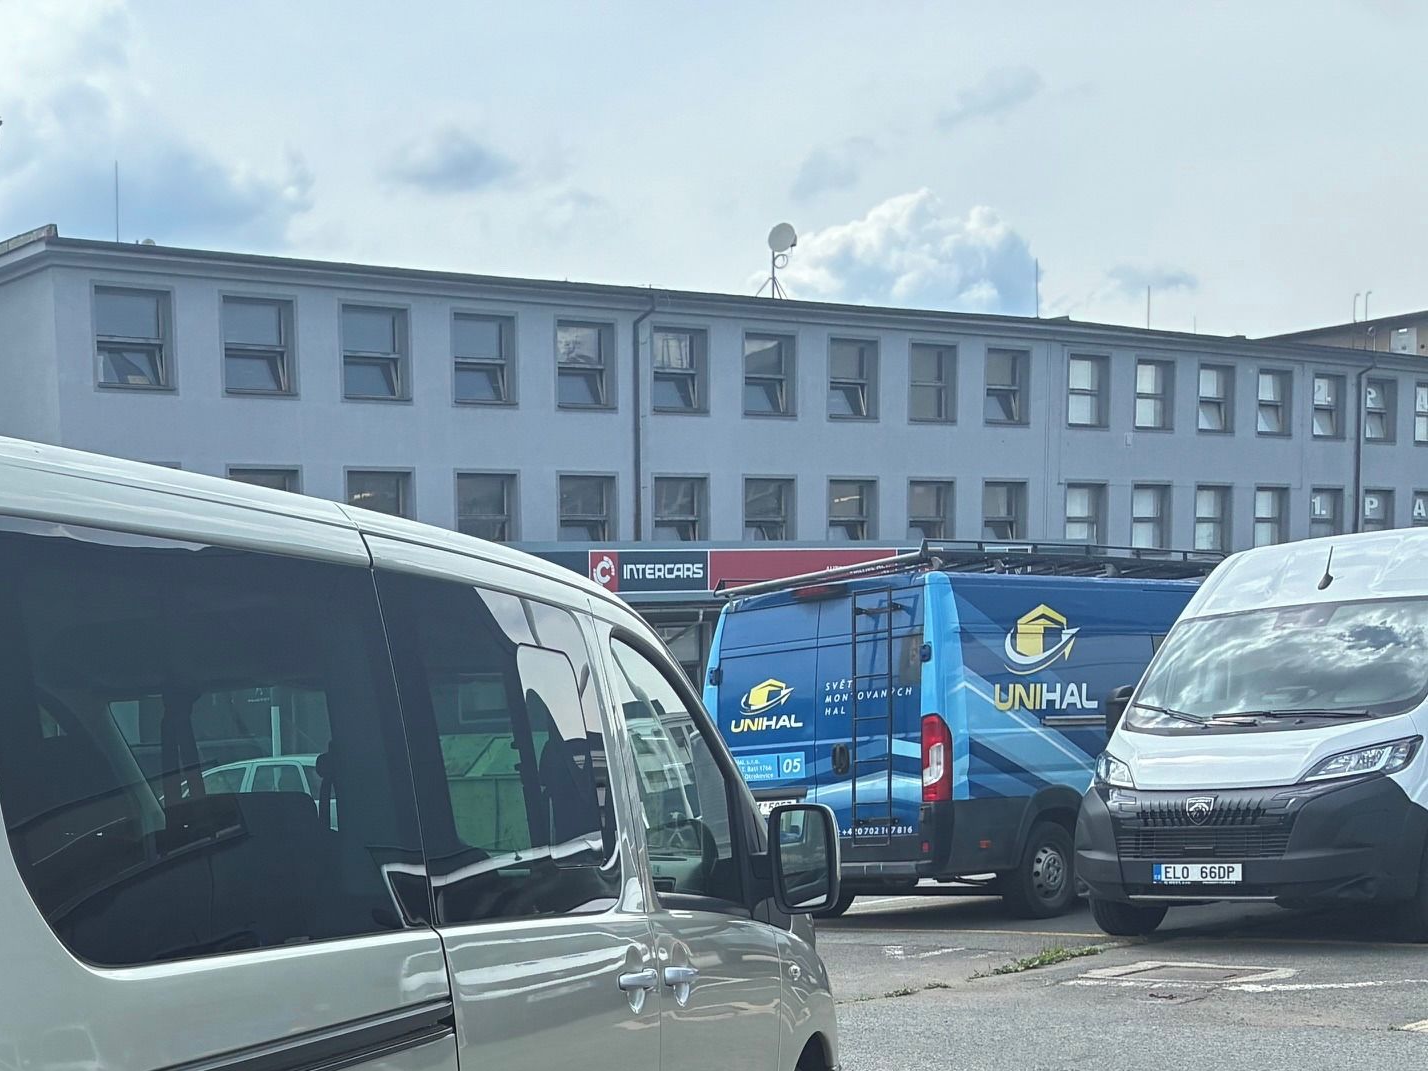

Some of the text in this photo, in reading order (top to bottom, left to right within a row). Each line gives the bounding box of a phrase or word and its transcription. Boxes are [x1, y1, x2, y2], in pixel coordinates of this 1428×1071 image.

[623, 563, 704, 579] INTERCARS
[824, 687, 913, 704] MONOVANCH
[993, 682, 1099, 711] UNIHAL
[824, 706, 846, 716] HAL
[730, 714, 804, 734] UNIHAL
[782, 758, 802, 774] 05
[1200, 866, 1235, 879] 66DP
